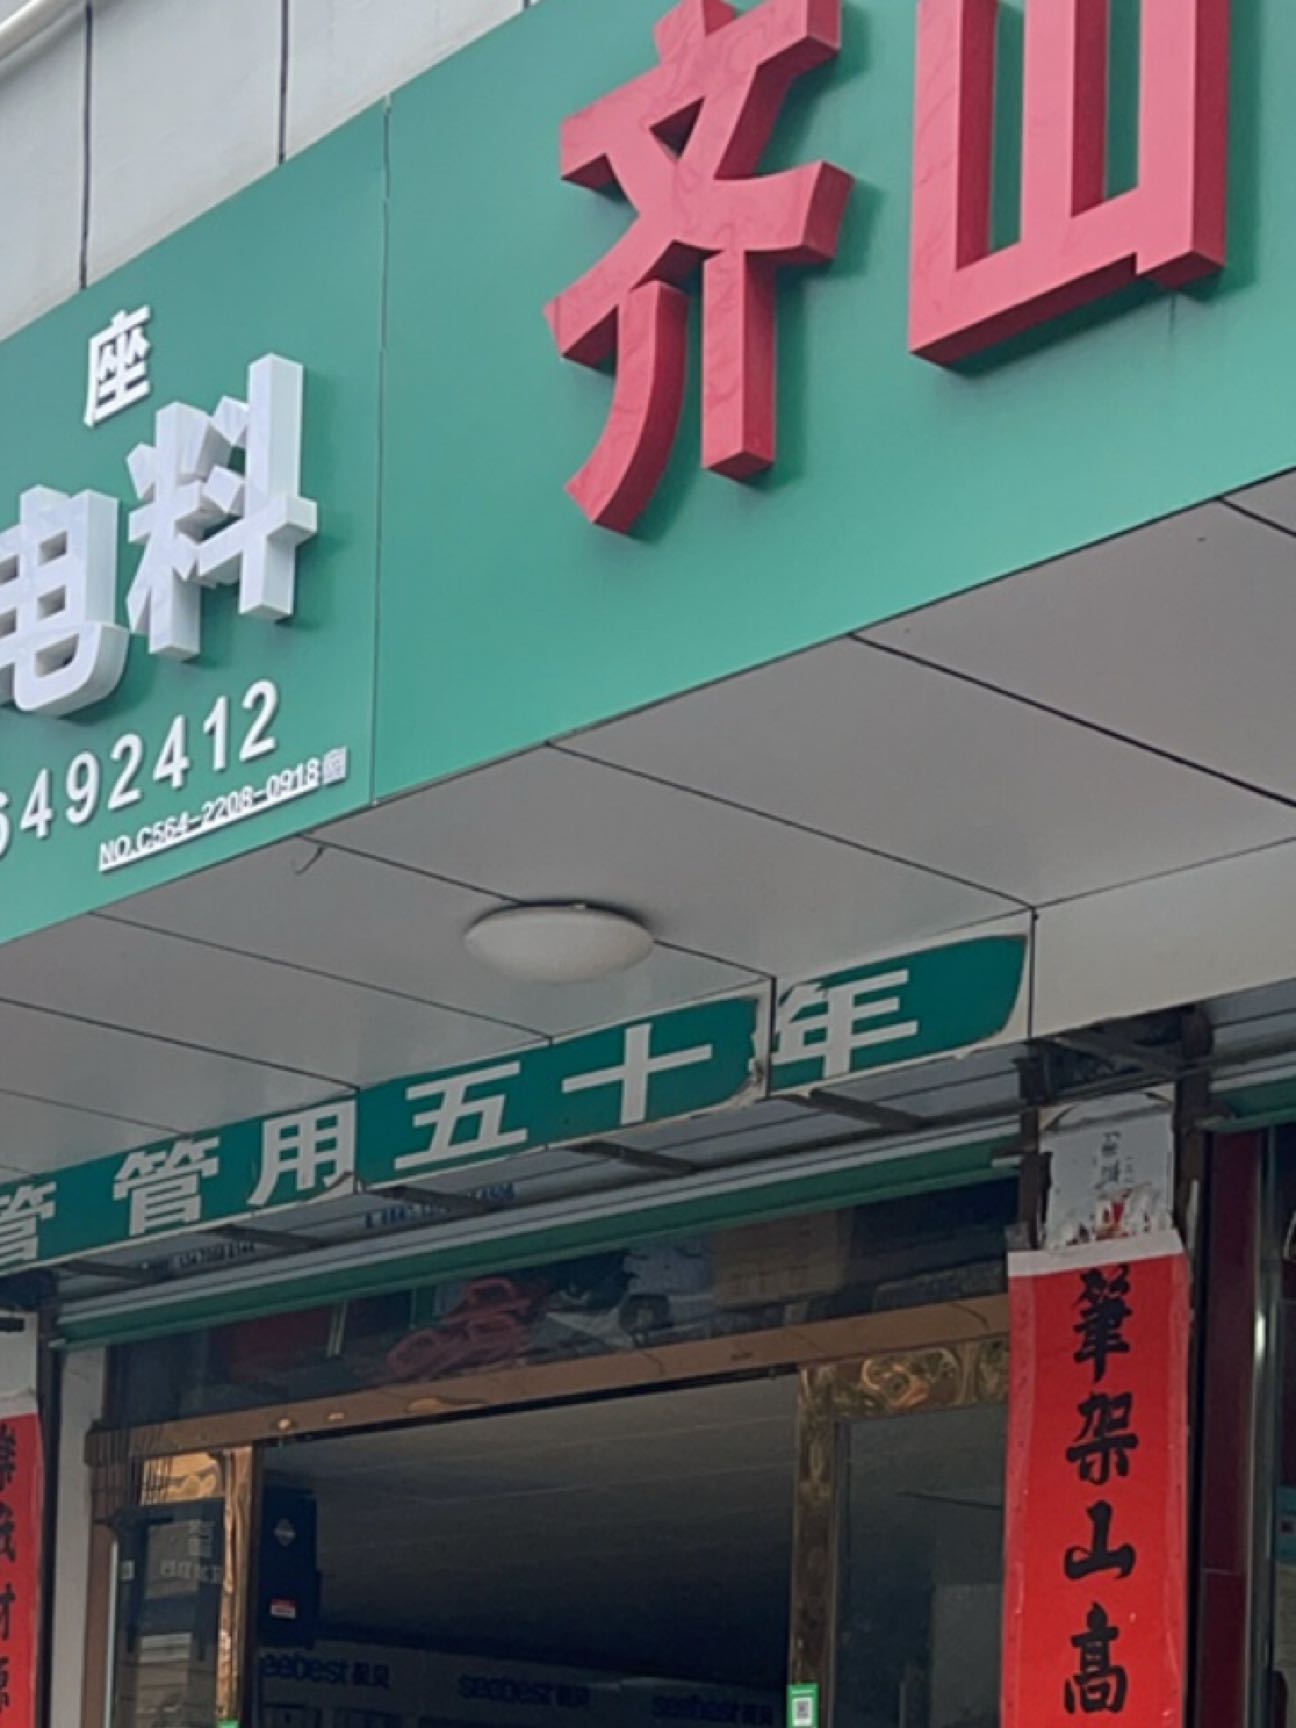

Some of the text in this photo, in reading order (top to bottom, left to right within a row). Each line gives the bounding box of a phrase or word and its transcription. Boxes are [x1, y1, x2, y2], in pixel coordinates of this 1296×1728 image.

[113, 968, 919, 1238] 管用五十年
